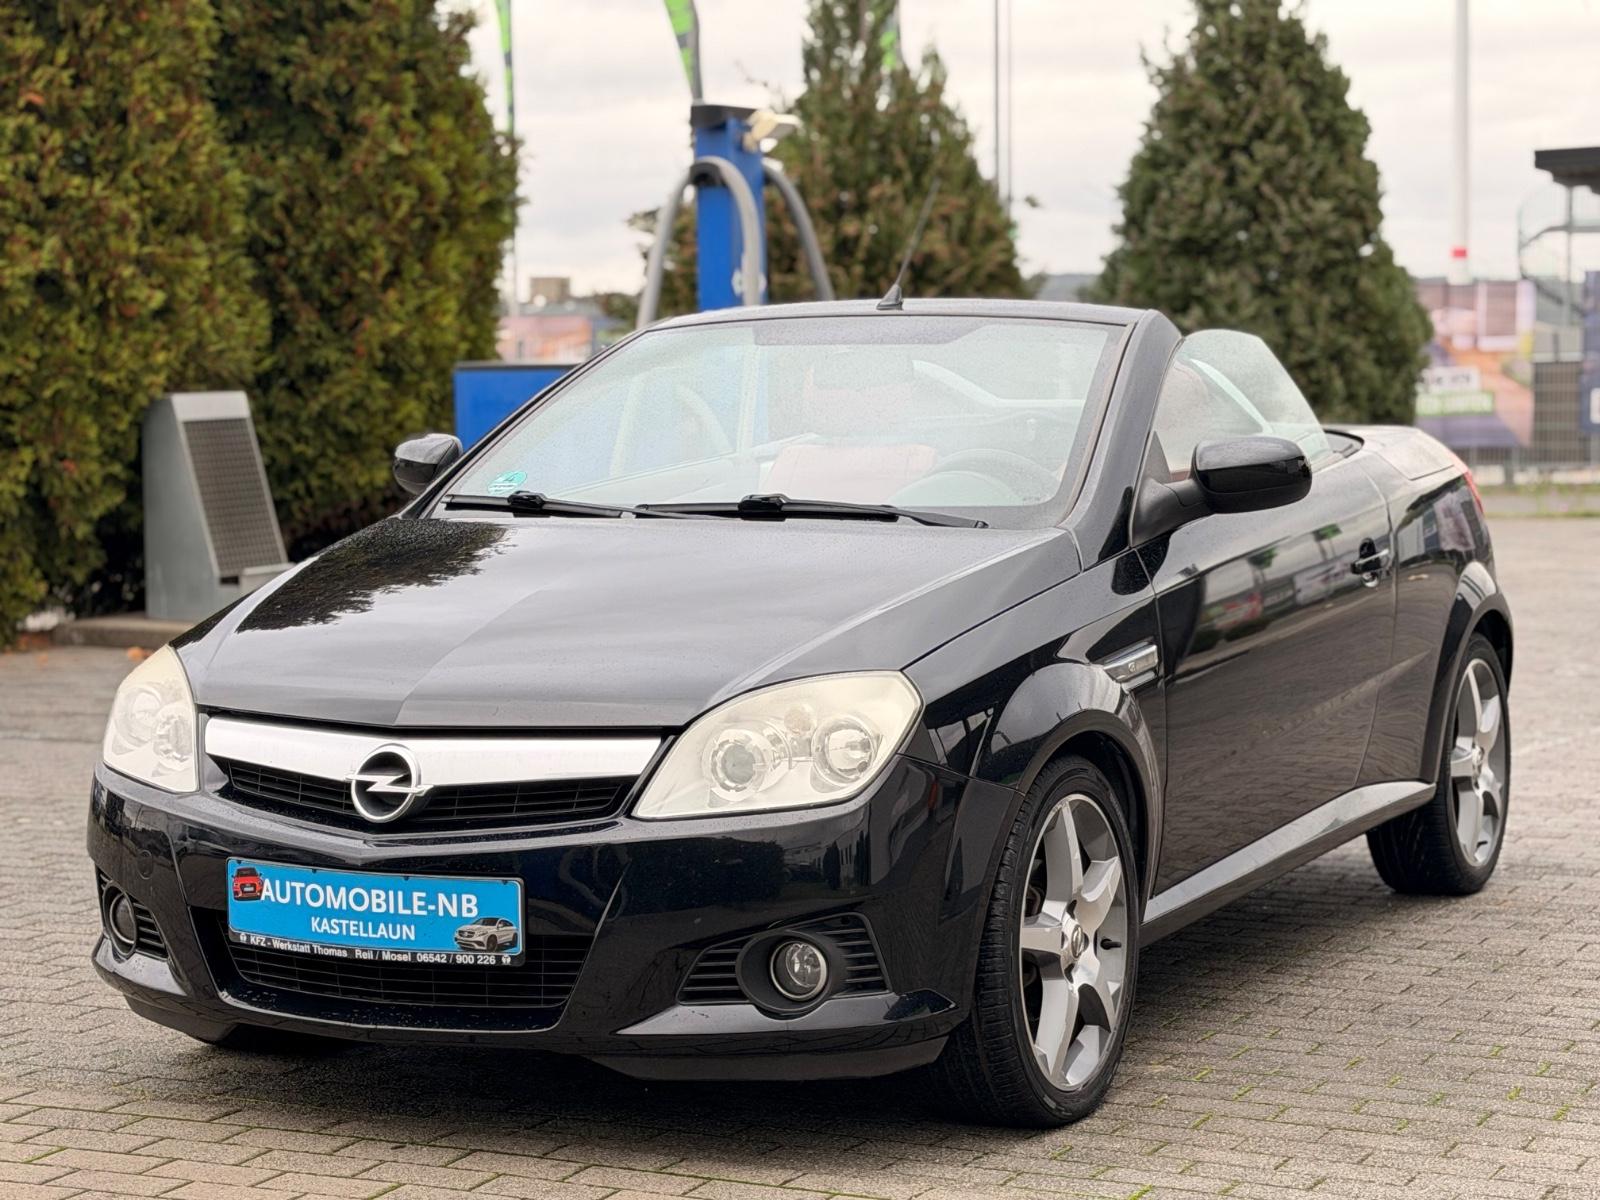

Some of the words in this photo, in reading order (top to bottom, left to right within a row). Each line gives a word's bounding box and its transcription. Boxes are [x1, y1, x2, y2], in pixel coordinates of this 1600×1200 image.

[261, 878, 478, 917] AUTOMOBILE-NB
[311, 916, 415, 940] KASTELLAUN
[250, 935, 266, 947] KFZ
[272, 939, 310, 953] Werkstatt
[312, 944, 348, 957] Thomas
[355, 949, 374, 960] Reil
[382, 951, 411, 962] Mosel
[417, 954, 447, 964] 06542
[456, 955, 475, 965] 900
[477, 956, 496, 965] 226
